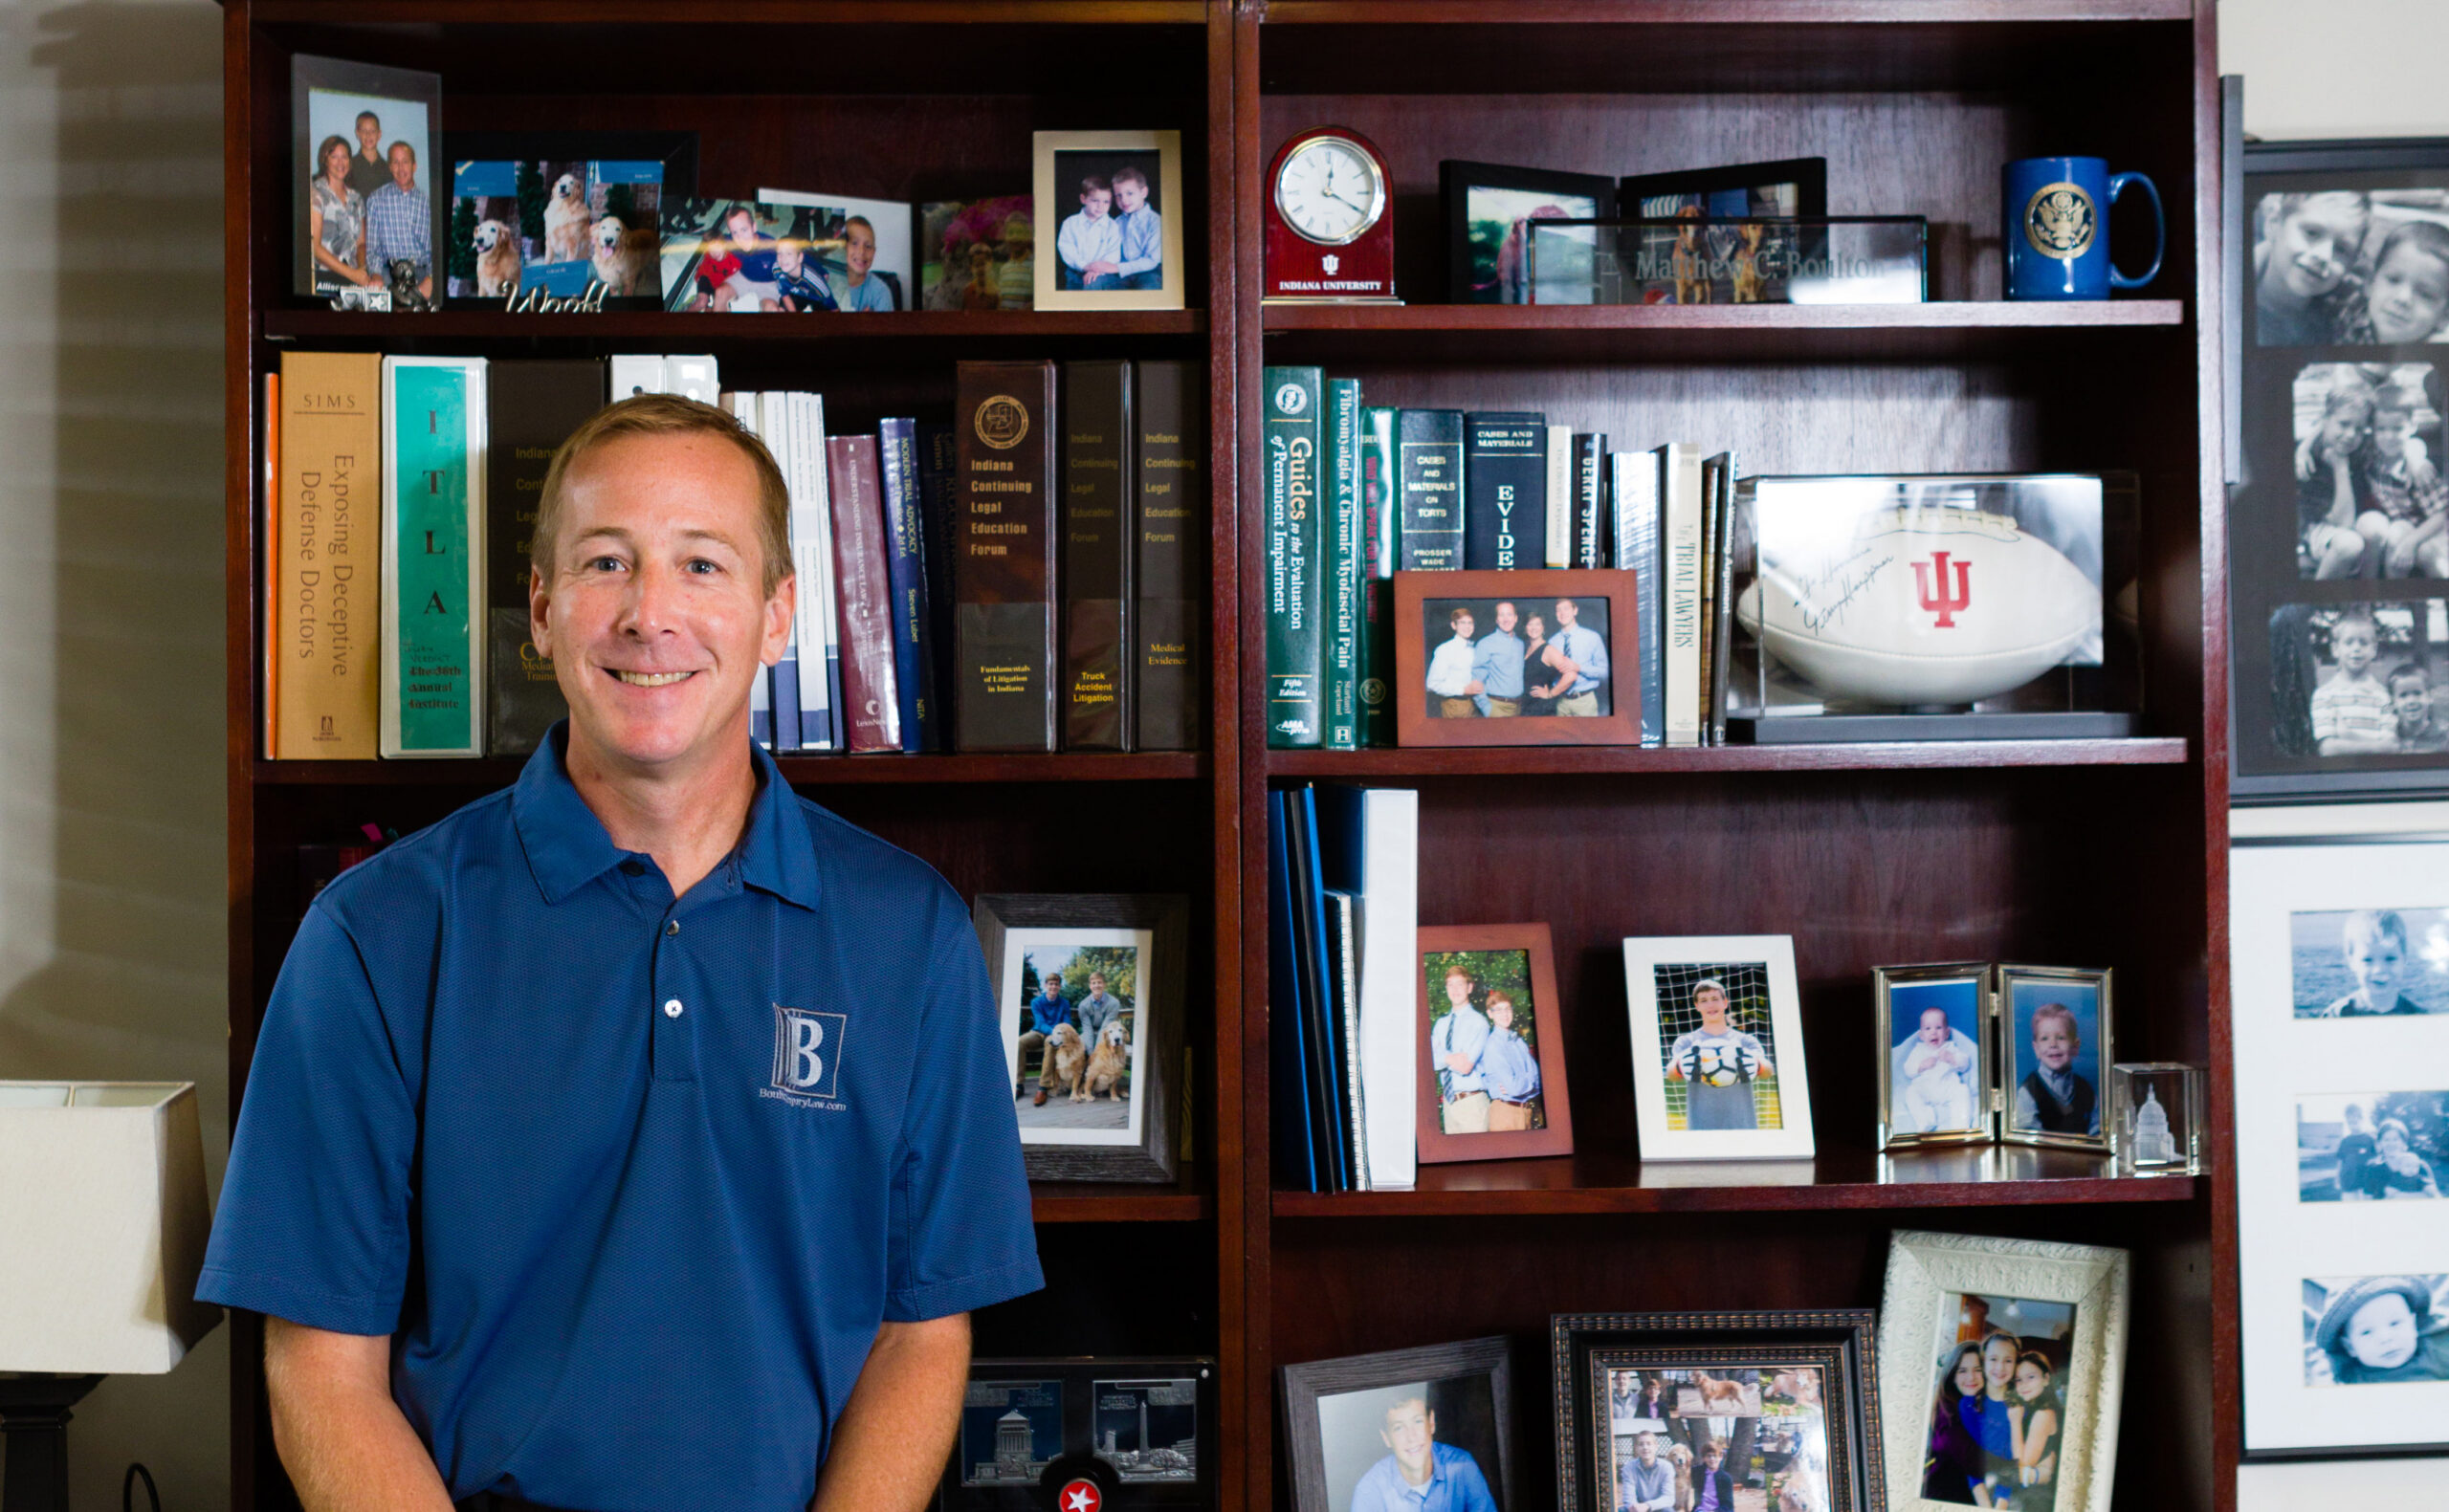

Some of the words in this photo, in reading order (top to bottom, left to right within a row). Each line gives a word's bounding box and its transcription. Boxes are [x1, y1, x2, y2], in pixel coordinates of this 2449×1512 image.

[1635, 251, 1745, 280] Matthew
[1753, 252, 1777, 279] C.
[1786, 252, 1886, 279] Boulton
[1279, 281, 1321, 291] INDIANA
[1322, 280, 1381, 291] UNIVERSITY
[303, 394, 356, 408] SIMS
[1145, 433, 1180, 444] Indiana
[1270, 435, 1286, 449] of
[1336, 389, 1353, 480] Fibromyalgia
[901, 437, 911, 476] MODERN
[971, 459, 1014, 471] Indiana
[1145, 458, 1196, 470] Continuing
[1417, 455, 1446, 465] CASES
[1366, 456, 1378, 480] WHO
[971, 480, 1032, 493] Continuing
[1290, 436, 1313, 520] Guides
[1407, 482, 1455, 492] MATERIALS
[1582, 457, 1596, 501] GERRY
[904, 478, 913, 502] TRIAL
[1145, 482, 1171, 495] Legal
[1273, 450, 1288, 527] Permanent
[1338, 483, 1352, 495] &
[328, 454, 355, 556] Exposing
[971, 501, 1003, 515] Legal
[1425, 495, 1439, 504] ON
[300, 471, 321, 561] Defense
[516, 511, 540, 524] Leg
[1145, 507, 1192, 517] Education
[1418, 508, 1446, 517] TORTS
[906, 505, 916, 554] ADVOCACY
[971, 522, 1027, 535] Education
[1290, 522, 1301, 535] to
[1338, 499, 1352, 555] Chronic
[1366, 506, 1378, 538] SPEAK
[1145, 532, 1176, 542] Forum
[1580, 508, 1596, 564] SPENCE
[970, 543, 1007, 556] Forum
[1291, 537, 1304, 554] the
[1366, 539, 1378, 560] FOR
[1269, 530, 1288, 614] Impairment
[1366, 561, 1378, 581] THE
[1675, 542, 1696, 585] TRIAL
[1291, 556, 1305, 629] Evaluation
[1722, 557, 1734, 614] Argument
[908, 588, 918, 618] Steven
[1336, 559, 1352, 632] Myofascial
[299, 570, 320, 659] Doctors
[327, 564, 354, 676] Deceptive
[1674, 589, 1696, 648] LAWYERS
[910, 619, 919, 643] Lubet
[1150, 643, 1185, 652] Medical
[1338, 636, 1352, 668] Pain
[981, 665, 1030, 673] Fundamentals
[1148, 656, 1188, 666] Evidence
[983, 674, 992, 683] of
[993, 674, 1027, 684] Litigation
[1074, 683, 1113, 691] Accident
[1072, 693, 1114, 704] Litigation
